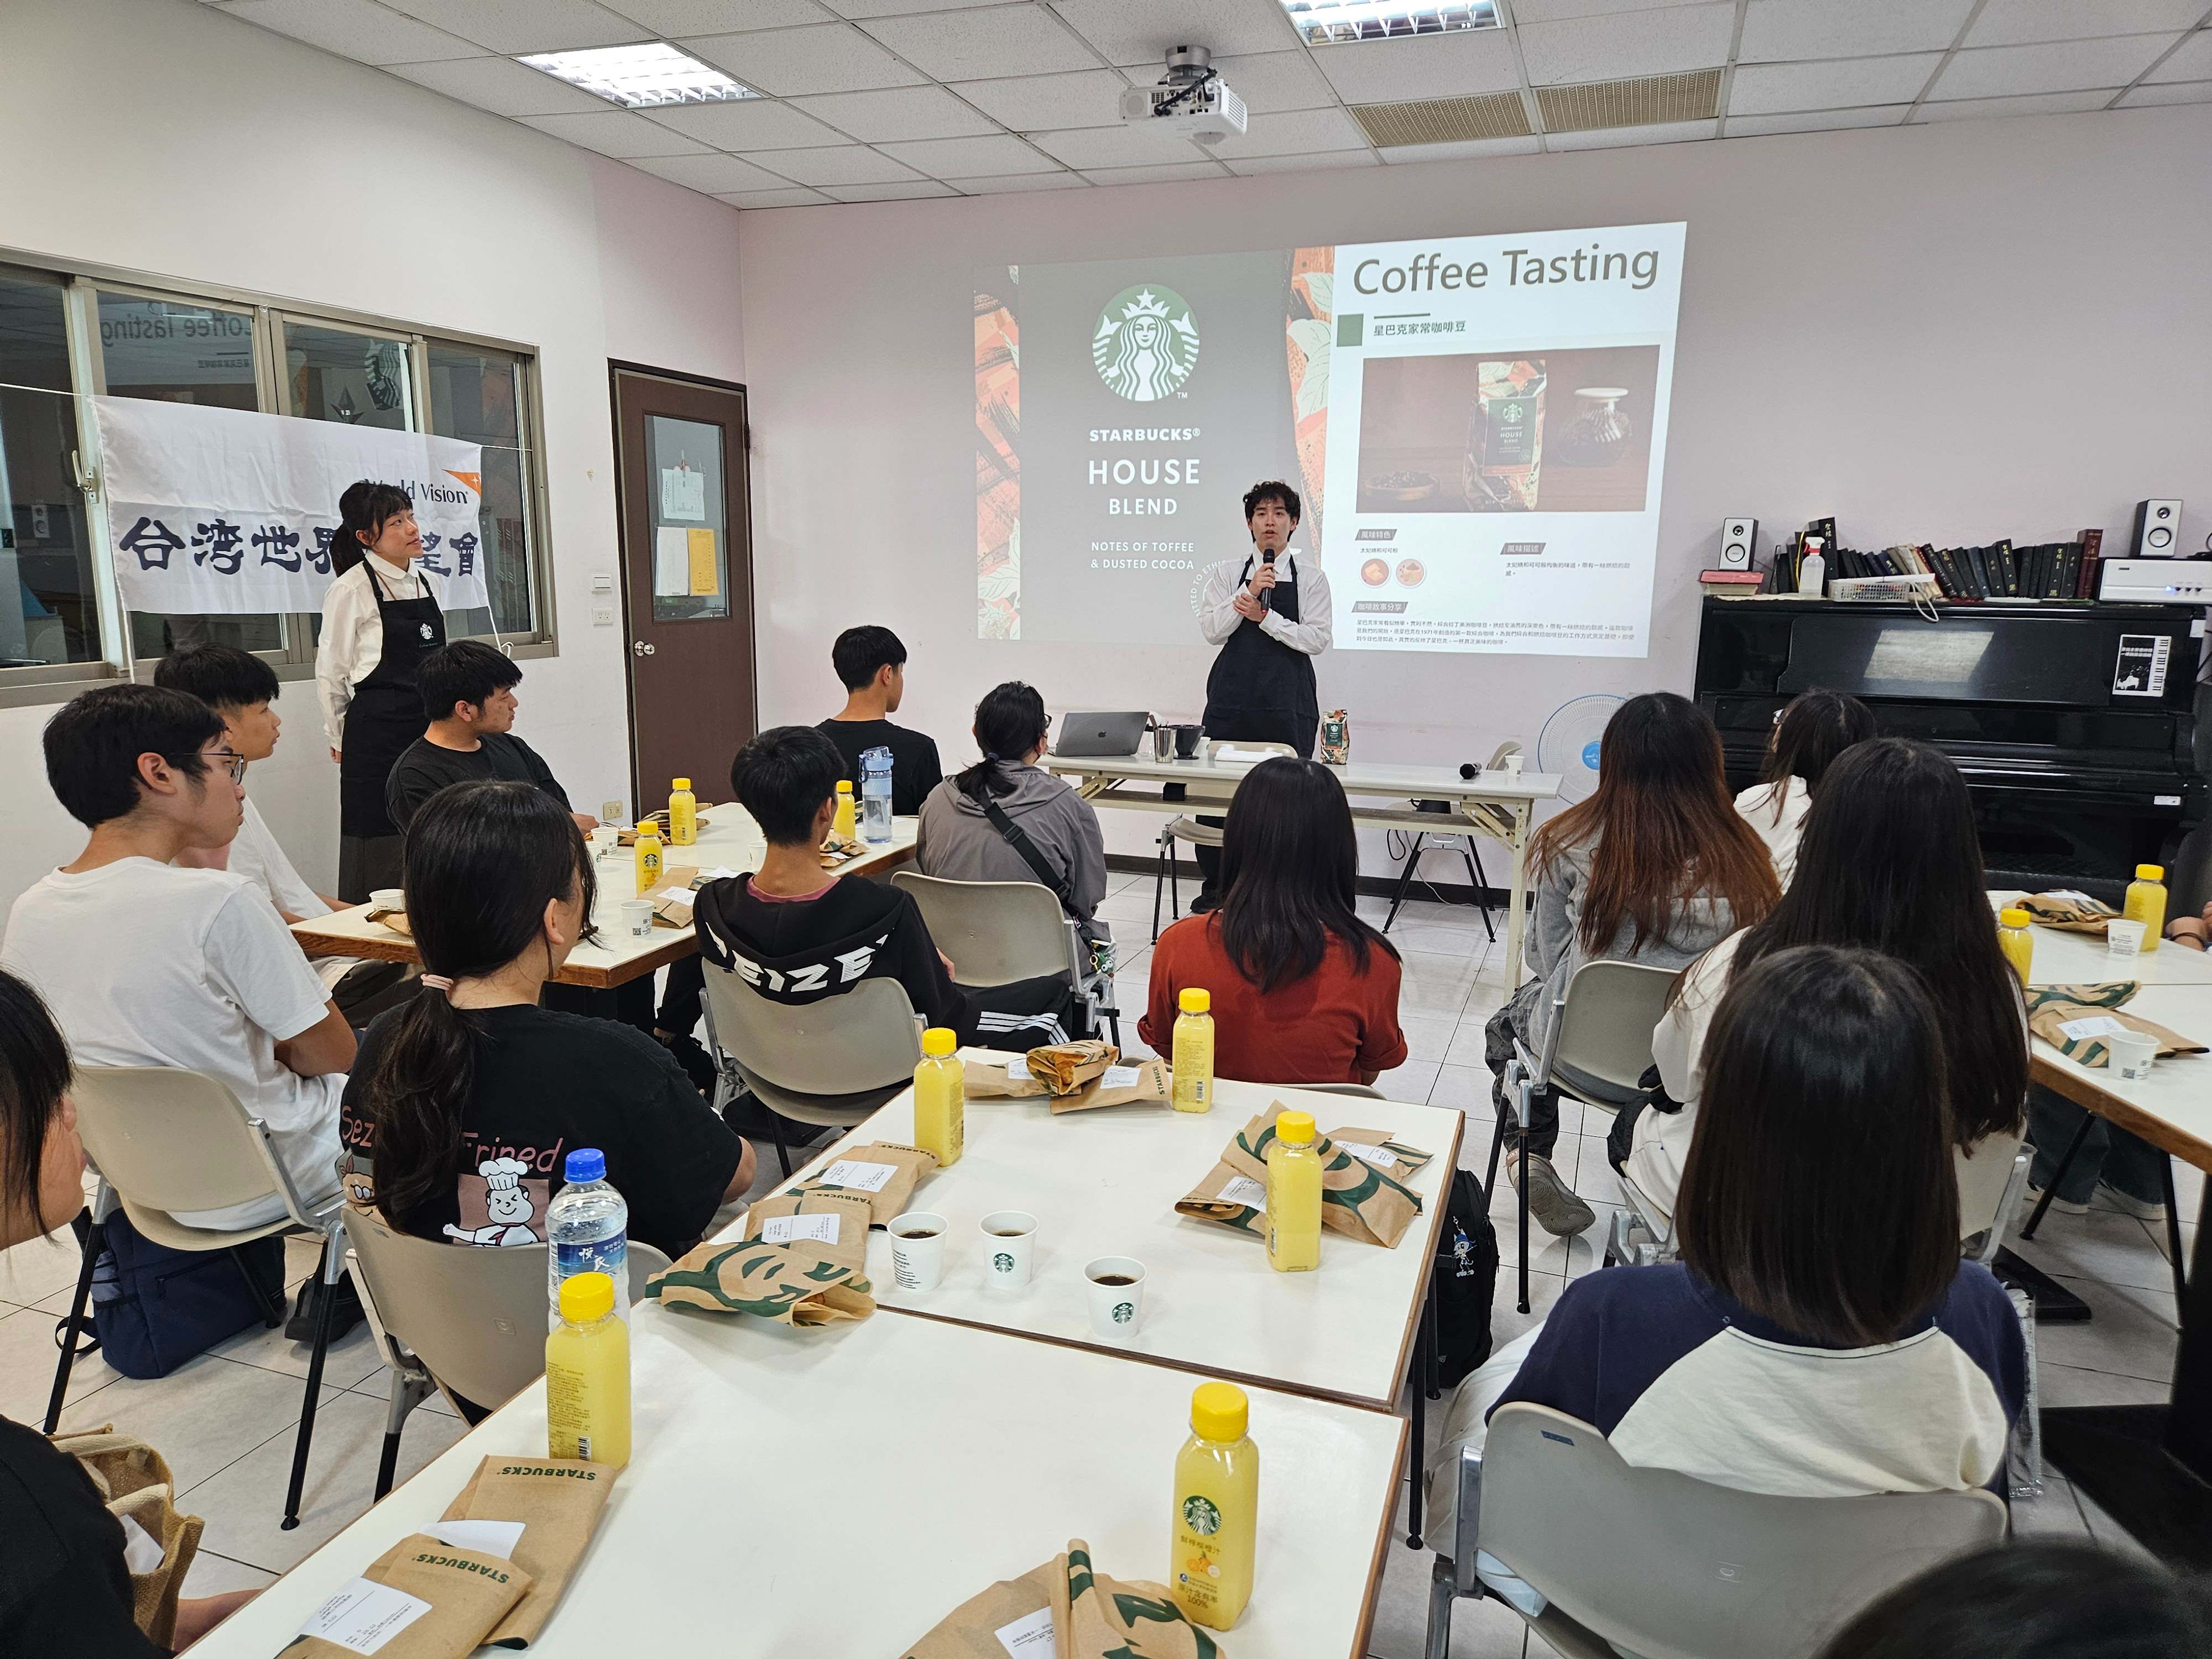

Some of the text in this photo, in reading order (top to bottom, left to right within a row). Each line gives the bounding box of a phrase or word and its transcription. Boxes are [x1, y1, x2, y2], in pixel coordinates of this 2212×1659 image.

[1353, 243, 1658, 295] Coffee Tasting
[1373, 320, 1467, 337] 星巴克家常咖啡豆
[1088, 460, 1200, 485] HOUSE
[1109, 499, 1177, 515] BLEND
[1091, 542, 1194, 552] NOTES OF TOFFEE
[1091, 559, 1194, 570] & DUSTED COCOA
[1193, 574, 1203, 585] TO
[706, 922, 888, 992] EIZE
[1152, 1066, 1165, 1095] STARBUCKS
[816, 1193, 872, 1206] TARBUCKS
[501, 1467, 597, 1481] STARBUCKS
[415, 1553, 510, 1584] STARBUCKS
[1187, 1595, 1208, 1609] 100%
